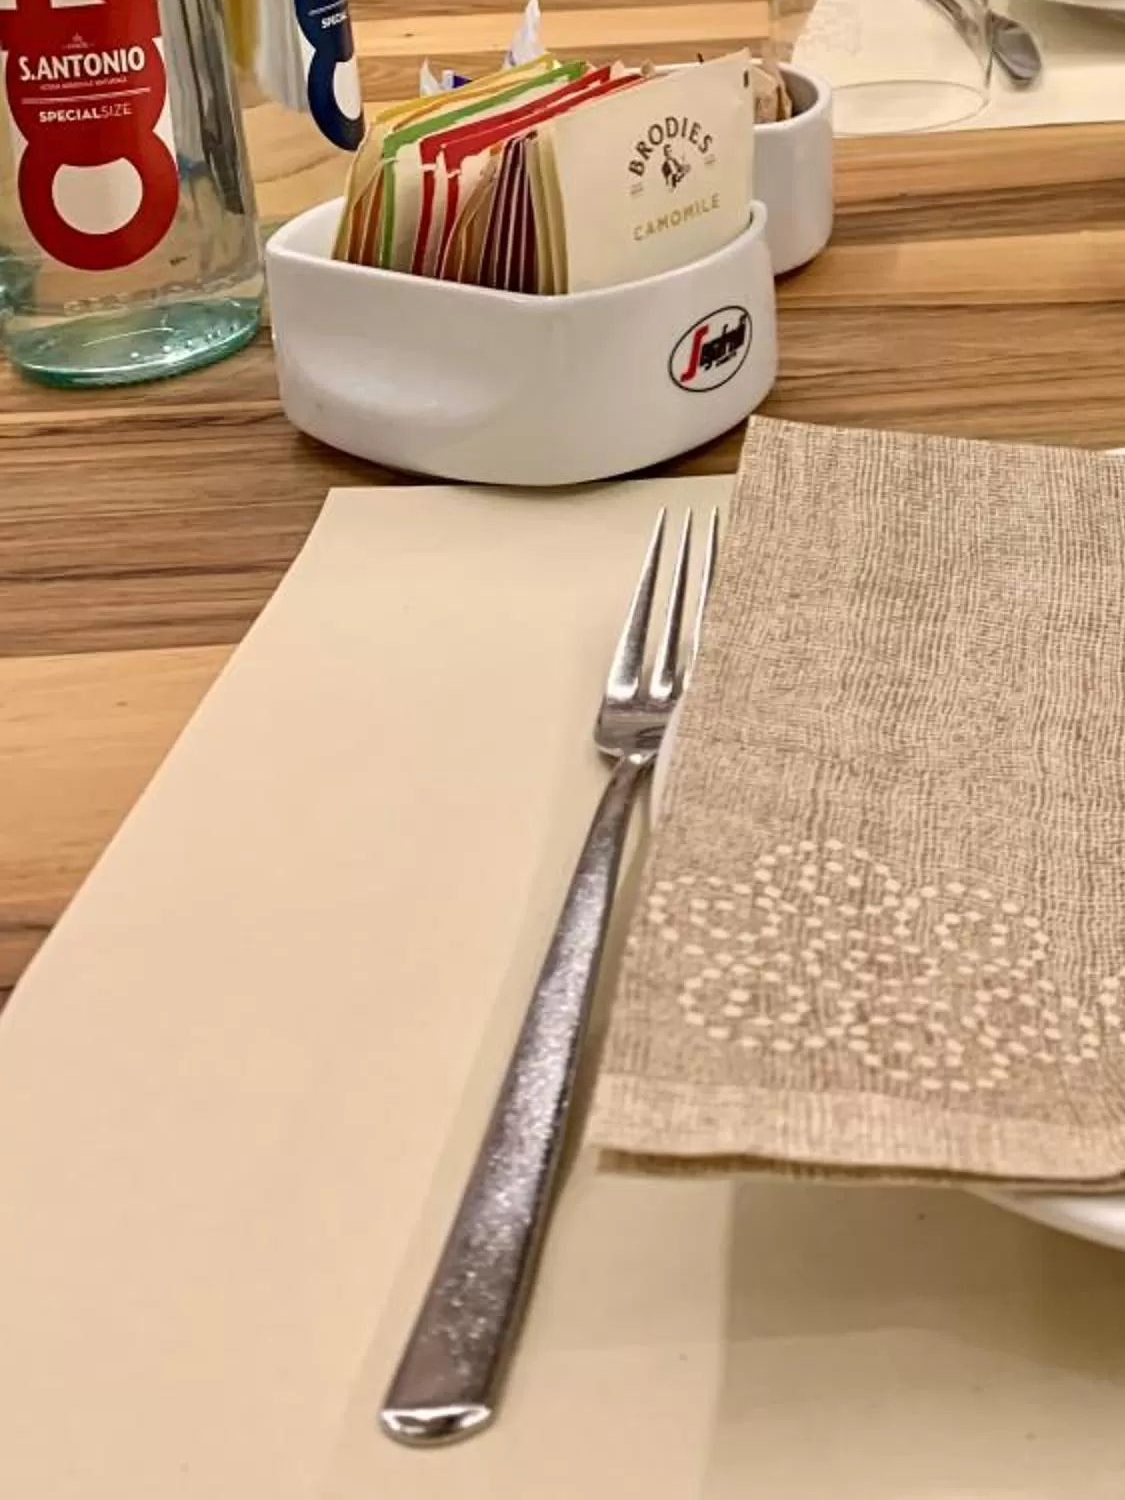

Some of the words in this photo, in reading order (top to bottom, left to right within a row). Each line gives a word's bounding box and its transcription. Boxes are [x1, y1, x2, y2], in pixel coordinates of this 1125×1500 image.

[18, 46, 146, 82] S.ANTONIO
[628, 116, 713, 178] BRODIES
[633, 192, 721, 241] CAMOMILE
